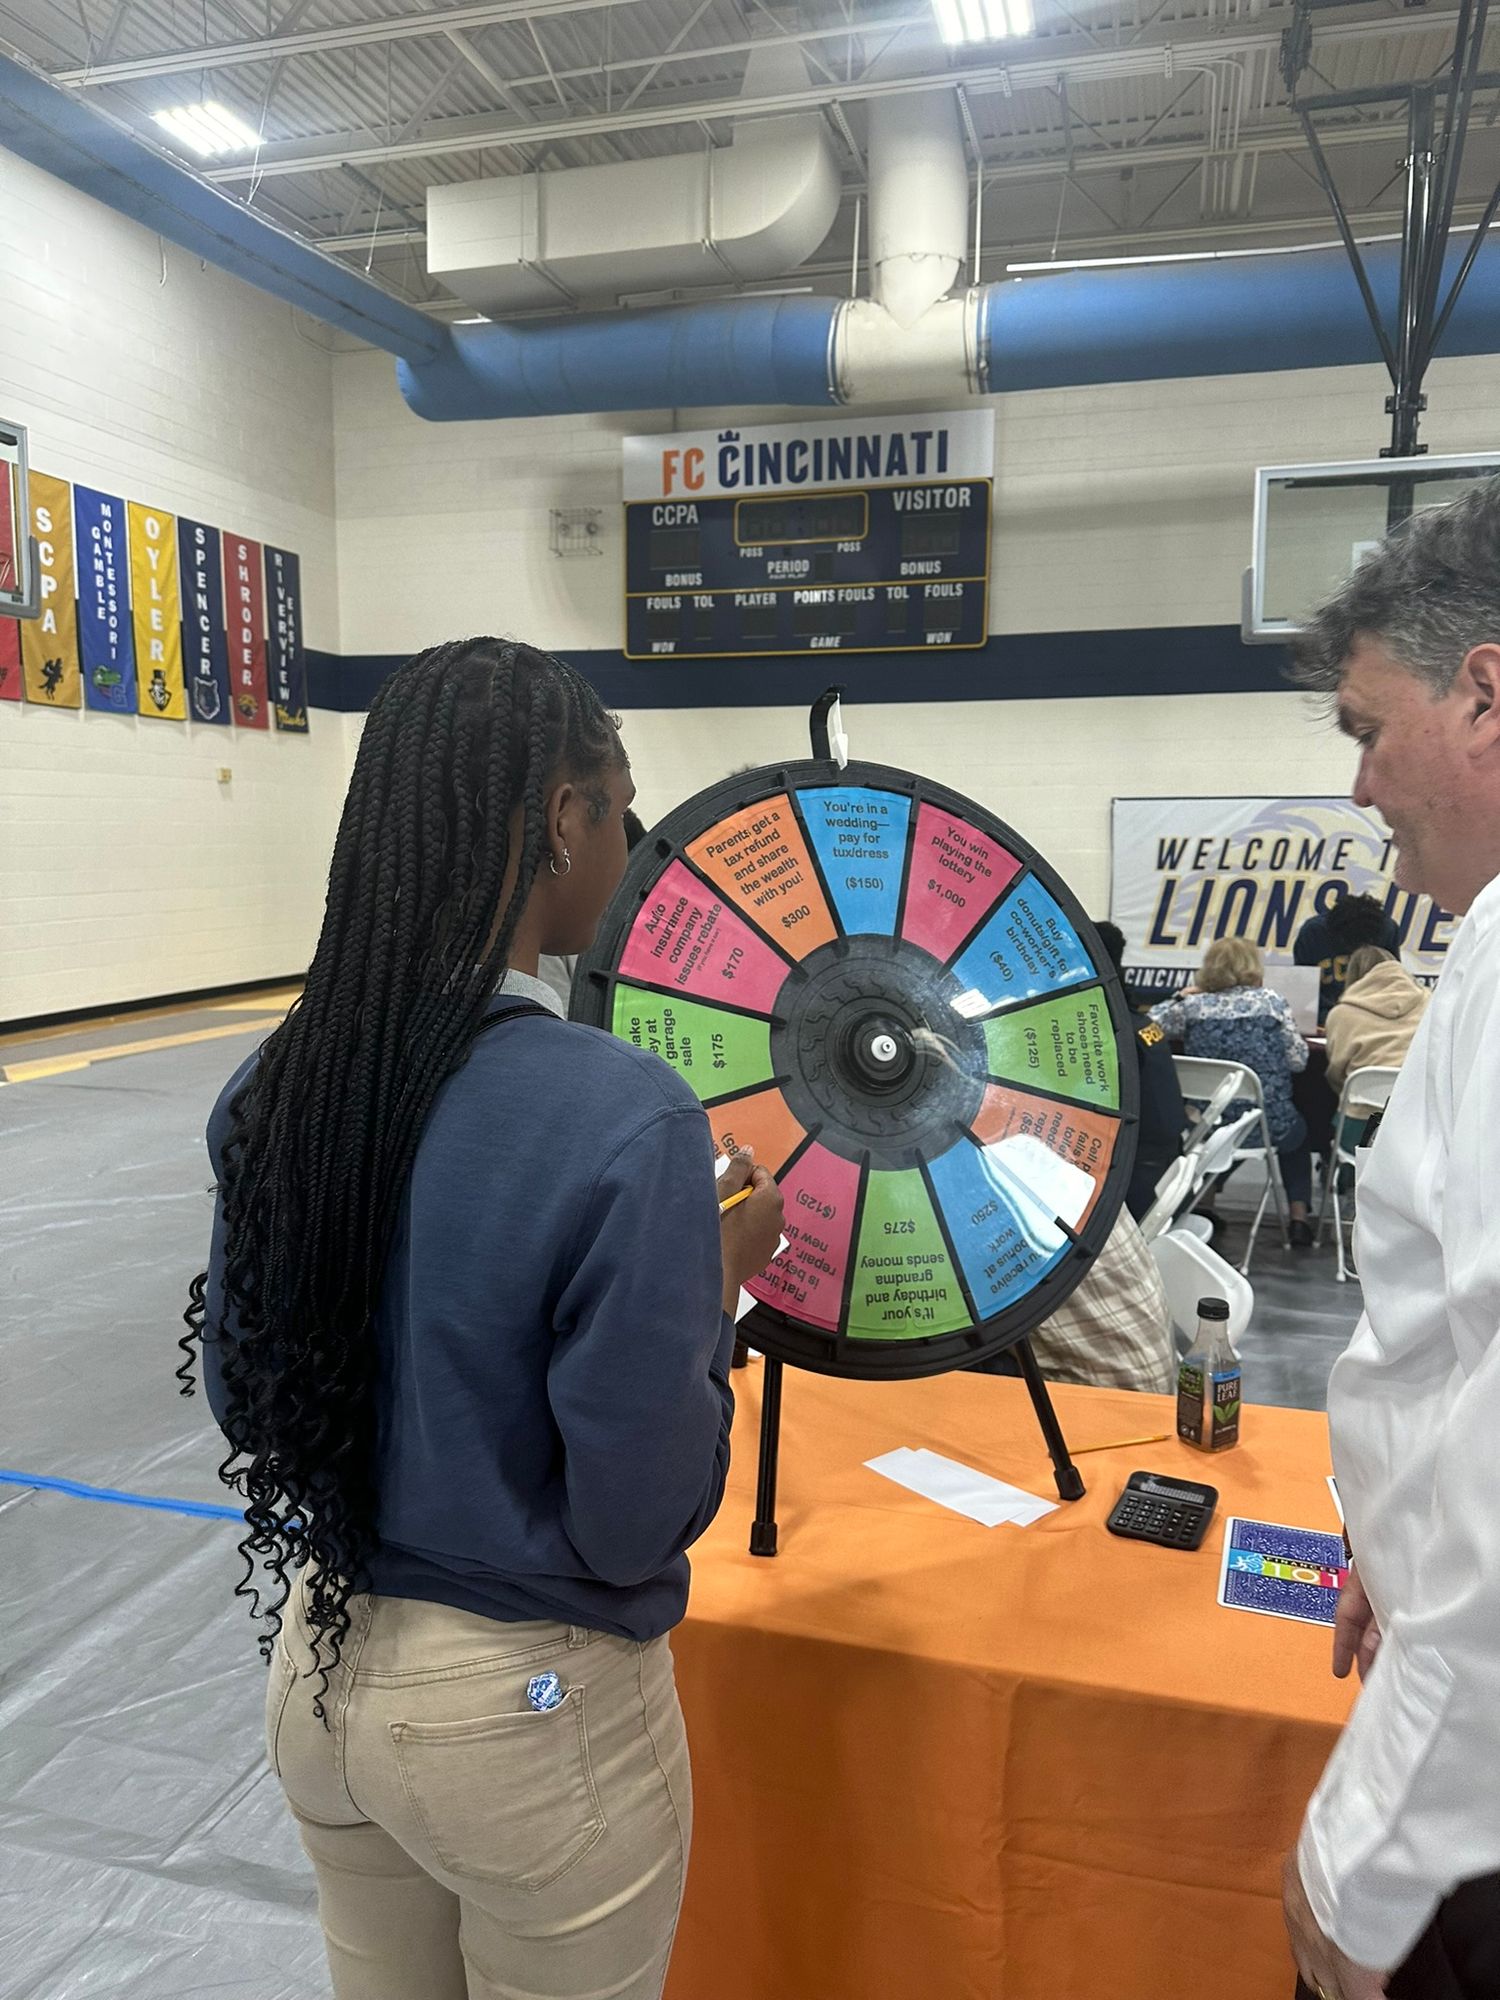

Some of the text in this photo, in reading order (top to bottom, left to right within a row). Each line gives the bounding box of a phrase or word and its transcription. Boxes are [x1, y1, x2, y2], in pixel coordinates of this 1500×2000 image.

[662, 430, 948, 497] FC CINCINNATI
[892, 487, 971, 511] VISITOR
[652, 504, 699, 526] CCPA
[837, 541, 861, 553] POSS
[35, 506, 58, 634] SCPA
[91, 526, 106, 620] GAMBLE
[101, 502, 117, 659] MONTESSORI
[665, 572, 703, 587] BONUS
[767, 560, 810, 574] PERIOD
[900, 560, 942, 576] BONUS
[145, 516, 164, 662] OYLER
[195, 528, 211, 676] SPENCER
[646, 583, 964, 610] FOULS TOL PLAYER POINTS FOULS TOL FOULS
[237, 544, 253, 686] SHRODER
[274, 553, 290, 700] RIVERVIEW
[810, 636, 842, 648] GAME
[926, 632, 952, 645] WON
[824, 801, 888, 814] You're in a
[706, 812, 780, 858] Parents get a
[723, 828, 781, 867] tax refund
[839, 832, 880, 845] pay for
[947, 826, 989, 859] You win
[734, 844, 789, 881] and share
[833, 846, 889, 859] tux/dress
[931, 836, 992, 877] playing the
[1157, 838, 1394, 871] WELCOME T
[740, 857, 799, 895] the wealth
[845, 876, 884, 891] ($150)
[938, 854, 976, 883] lottery
[753, 871, 804, 907] with you!
[928, 879, 966, 908] $1,000
[644, 903, 666, 935] Auto
[650, 896, 689, 958] insurance
[781, 904, 811, 929] $300
[1017, 898, 1060, 959] donuts/gift
[1045, 918, 1063, 940] Buy
[669, 907, 703, 964] company
[674, 903, 722, 985] issues rebate
[1006, 926, 1040, 975] birthday
[1010, 911, 1057, 978] co-worker's
[721, 947, 744, 979] $170
[989, 950, 1014, 982] ($40)
[645, 1018, 657, 1033] at
[663, 1008, 678, 1060] garage
[680, 1036, 693, 1066] sale
[711, 1033, 727, 1069] $175
[1024, 1027, 1040, 1069] ($125)
[1051, 1019, 1068, 1077] replaced
[1066, 1032, 1078, 1064] to be
[1077, 1011, 1096, 1085] shoes need
[1088, 1004, 1110, 1092] Favorite work
[721, 1132, 740, 1156] 85)
[1072, 1131, 1089, 1157] falls
[1087, 1137, 1102, 1163] Cell
[796, 1188, 837, 1220] ($125)
[971, 1199, 998, 1226] $250
[784, 1223, 800, 1239] tir
[883, 1218, 916, 1234] $275
[987, 1228, 1016, 1253] work
[801, 1232, 829, 1253] new
[996, 1238, 1030, 1268] bonus
[771, 1257, 820, 1290] is beyo
[795, 1246, 837, 1277] repair.
[860, 1253, 945, 1269] sends money
[984, 1264, 997, 1279] at
[781, 1280, 807, 1303] Flat
[875, 1268, 933, 1287] grandma
[990, 1259, 1029, 1294] receive
[865, 1288, 947, 1307] birthday and
[881, 1305, 935, 1320] It's your
[1217, 1380, 1238, 1393] PURE
[1217, 1390, 1237, 1402] LEAF
[1271, 1563, 1339, 1588] 101
